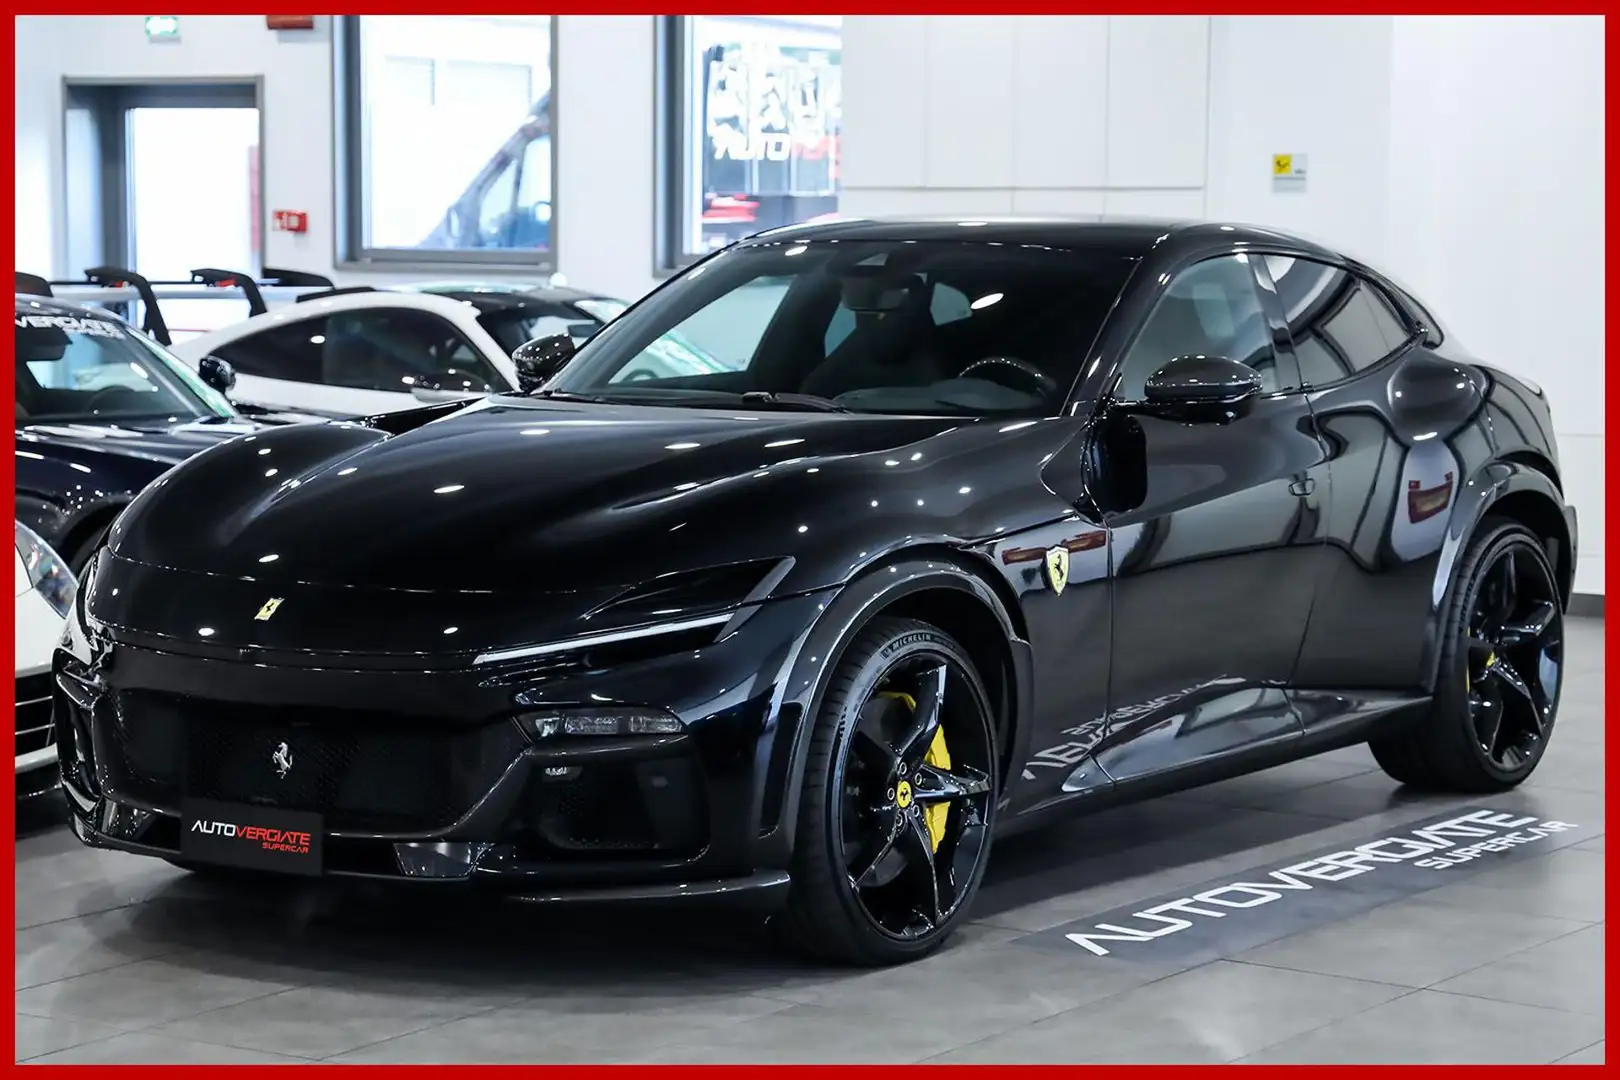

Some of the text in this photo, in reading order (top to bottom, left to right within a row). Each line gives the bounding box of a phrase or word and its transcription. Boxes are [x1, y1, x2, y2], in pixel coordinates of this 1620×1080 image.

[891, 633, 931, 651] MICHELIN
[191, 819, 311, 846] AUTOVERGIATE
[1415, 819, 1578, 870] SUPERCAR
[262, 842, 309, 854] SUPERCAR
[1065, 808, 1538, 956] AUTOVERGIATE
